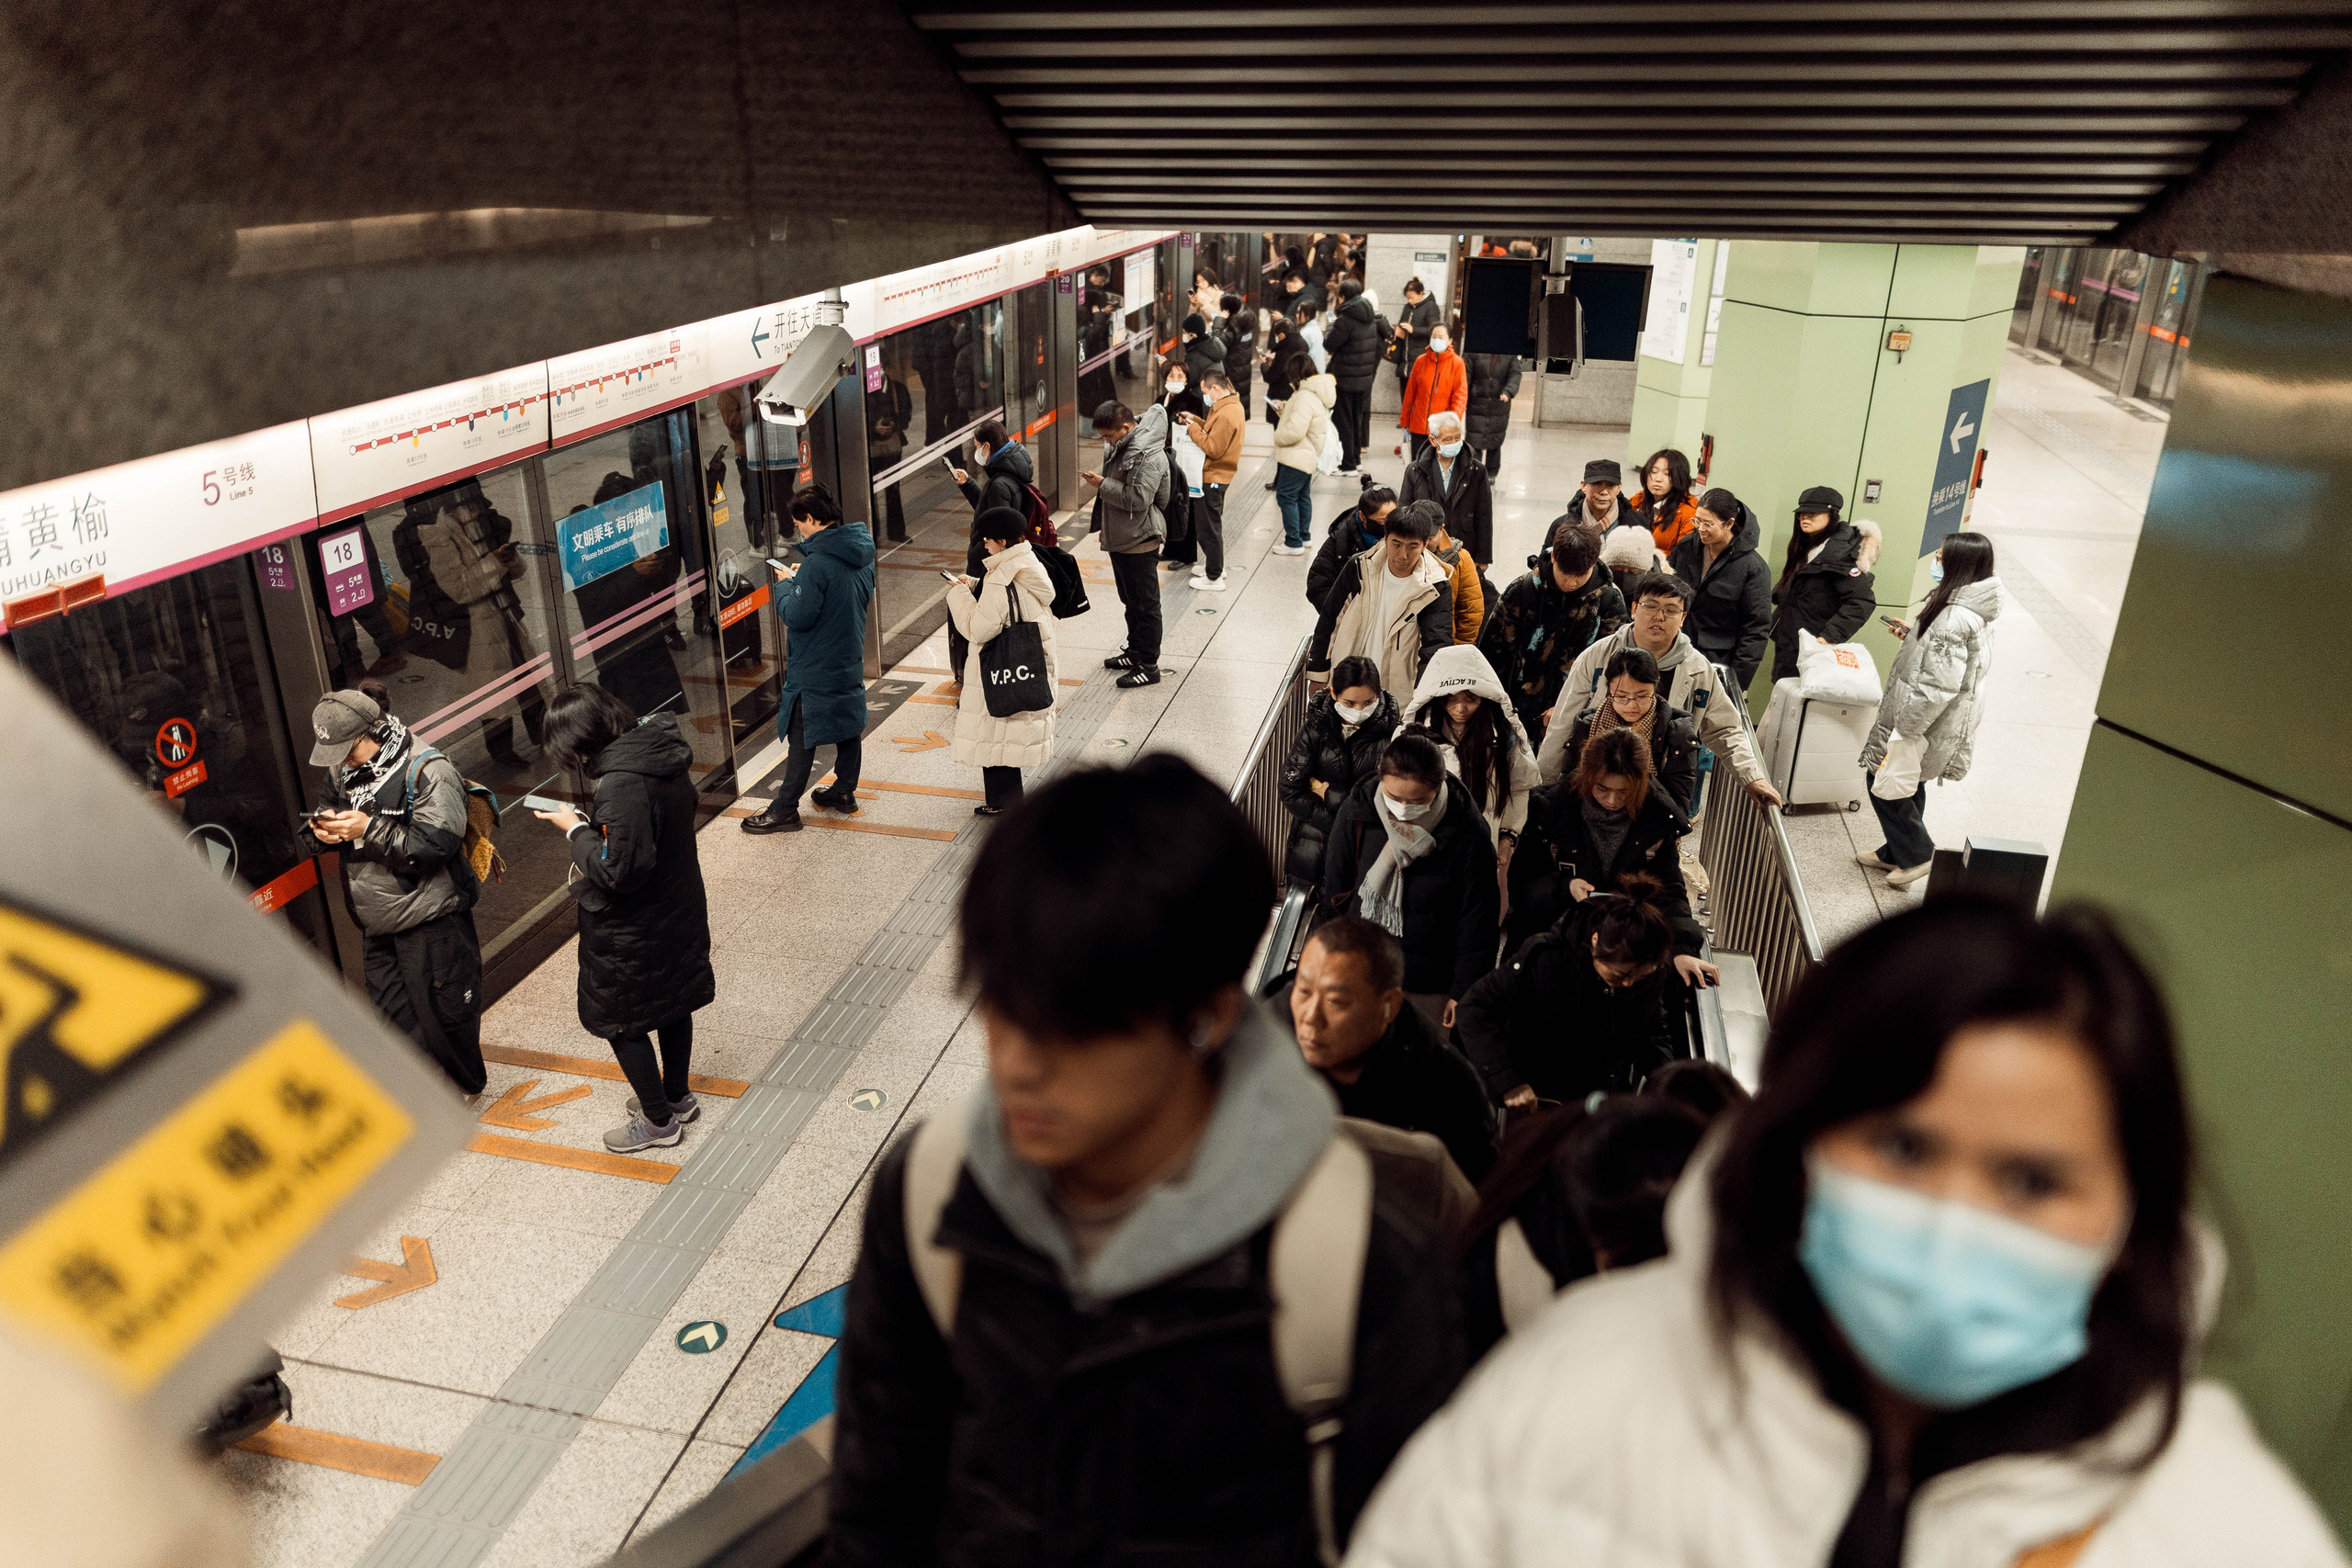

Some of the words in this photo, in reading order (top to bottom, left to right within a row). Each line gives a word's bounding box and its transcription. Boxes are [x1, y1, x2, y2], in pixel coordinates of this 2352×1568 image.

[775, 345, 781, 354] To
[230, 490, 246, 501] Line
[248, 487, 254, 495] 5
[572, 521, 614, 553] 文明乘车
[616, 503, 653, 534] 有序排队
[262, 547, 284, 564] 18
[334, 542, 353, 563] 18
[581, 551, 597, 562] Please
[604, 538, 628, 553] considerate
[1440, 678, 1466, 688] ACTIVE
